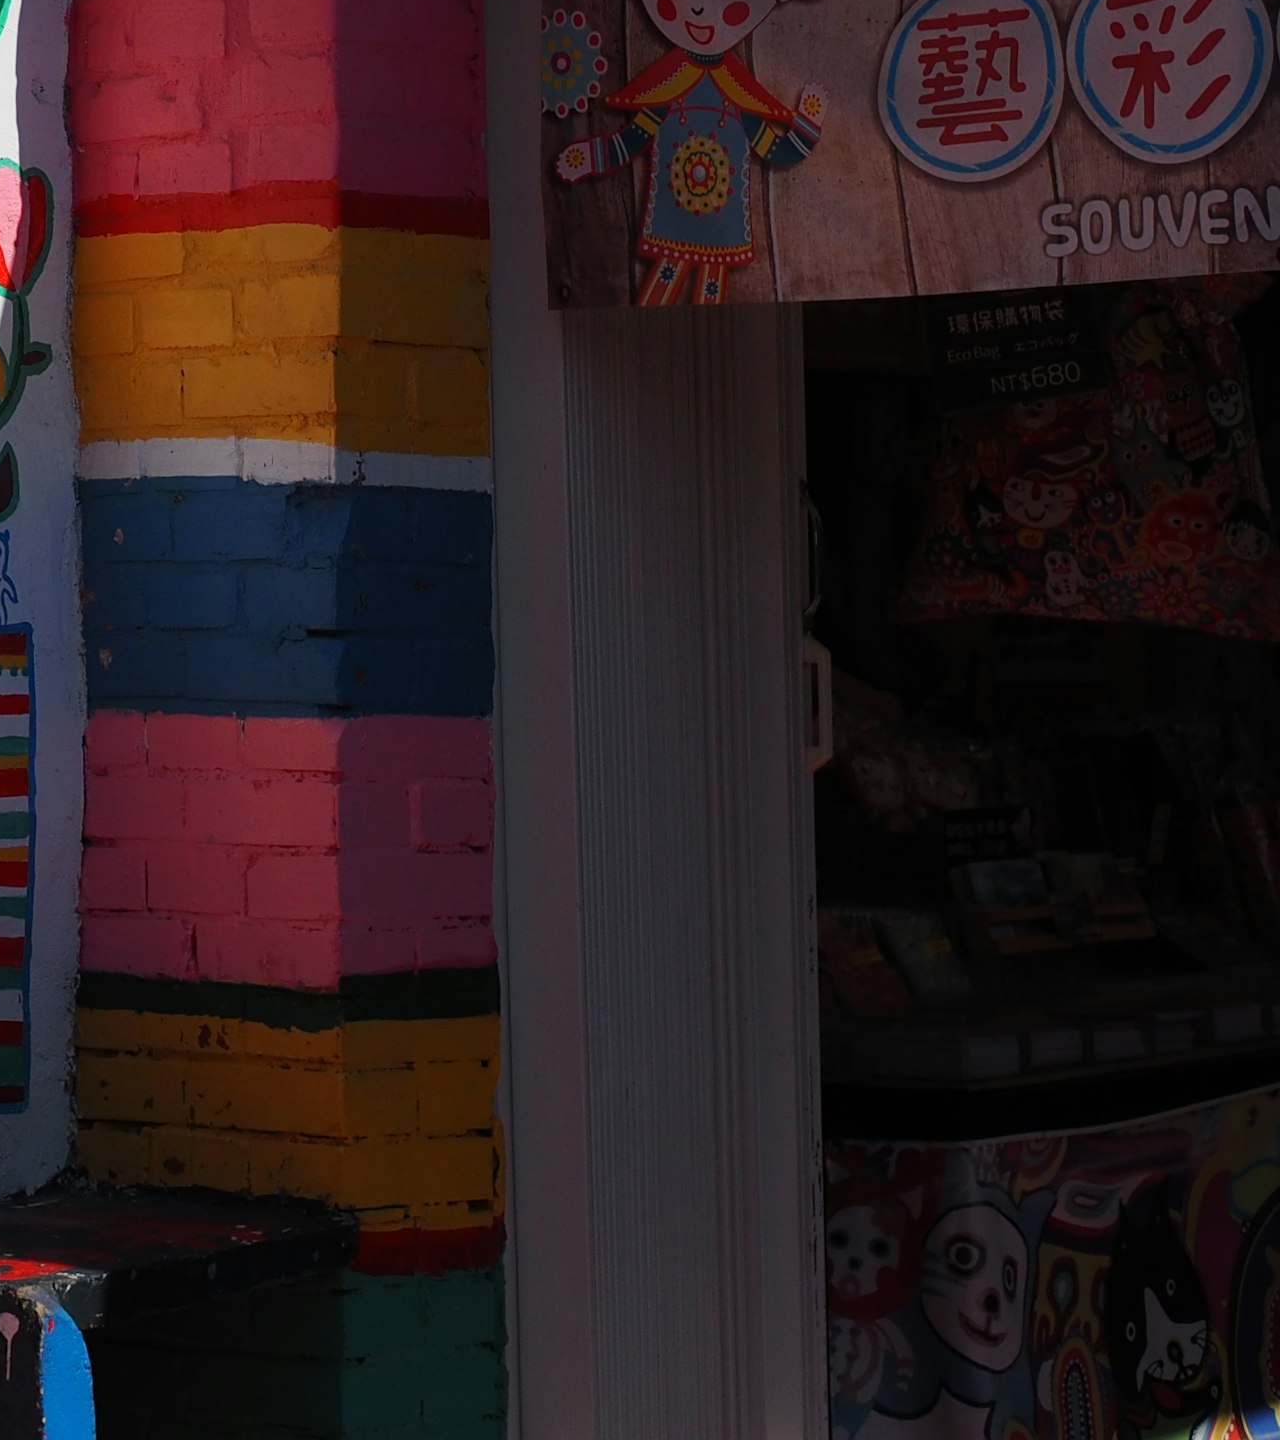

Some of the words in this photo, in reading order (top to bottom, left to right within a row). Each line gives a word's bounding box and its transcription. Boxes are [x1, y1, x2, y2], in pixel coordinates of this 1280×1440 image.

[1041, 185, 1280, 257] SOUVEN
[947, 300, 1065, 335] 環保購物袋
[947, 350, 971, 364] Eco
[975, 346, 1002, 361] Bag
[1013, 332, 1079, 353] エコバッグ
[991, 361, 1081, 394] NT$680
